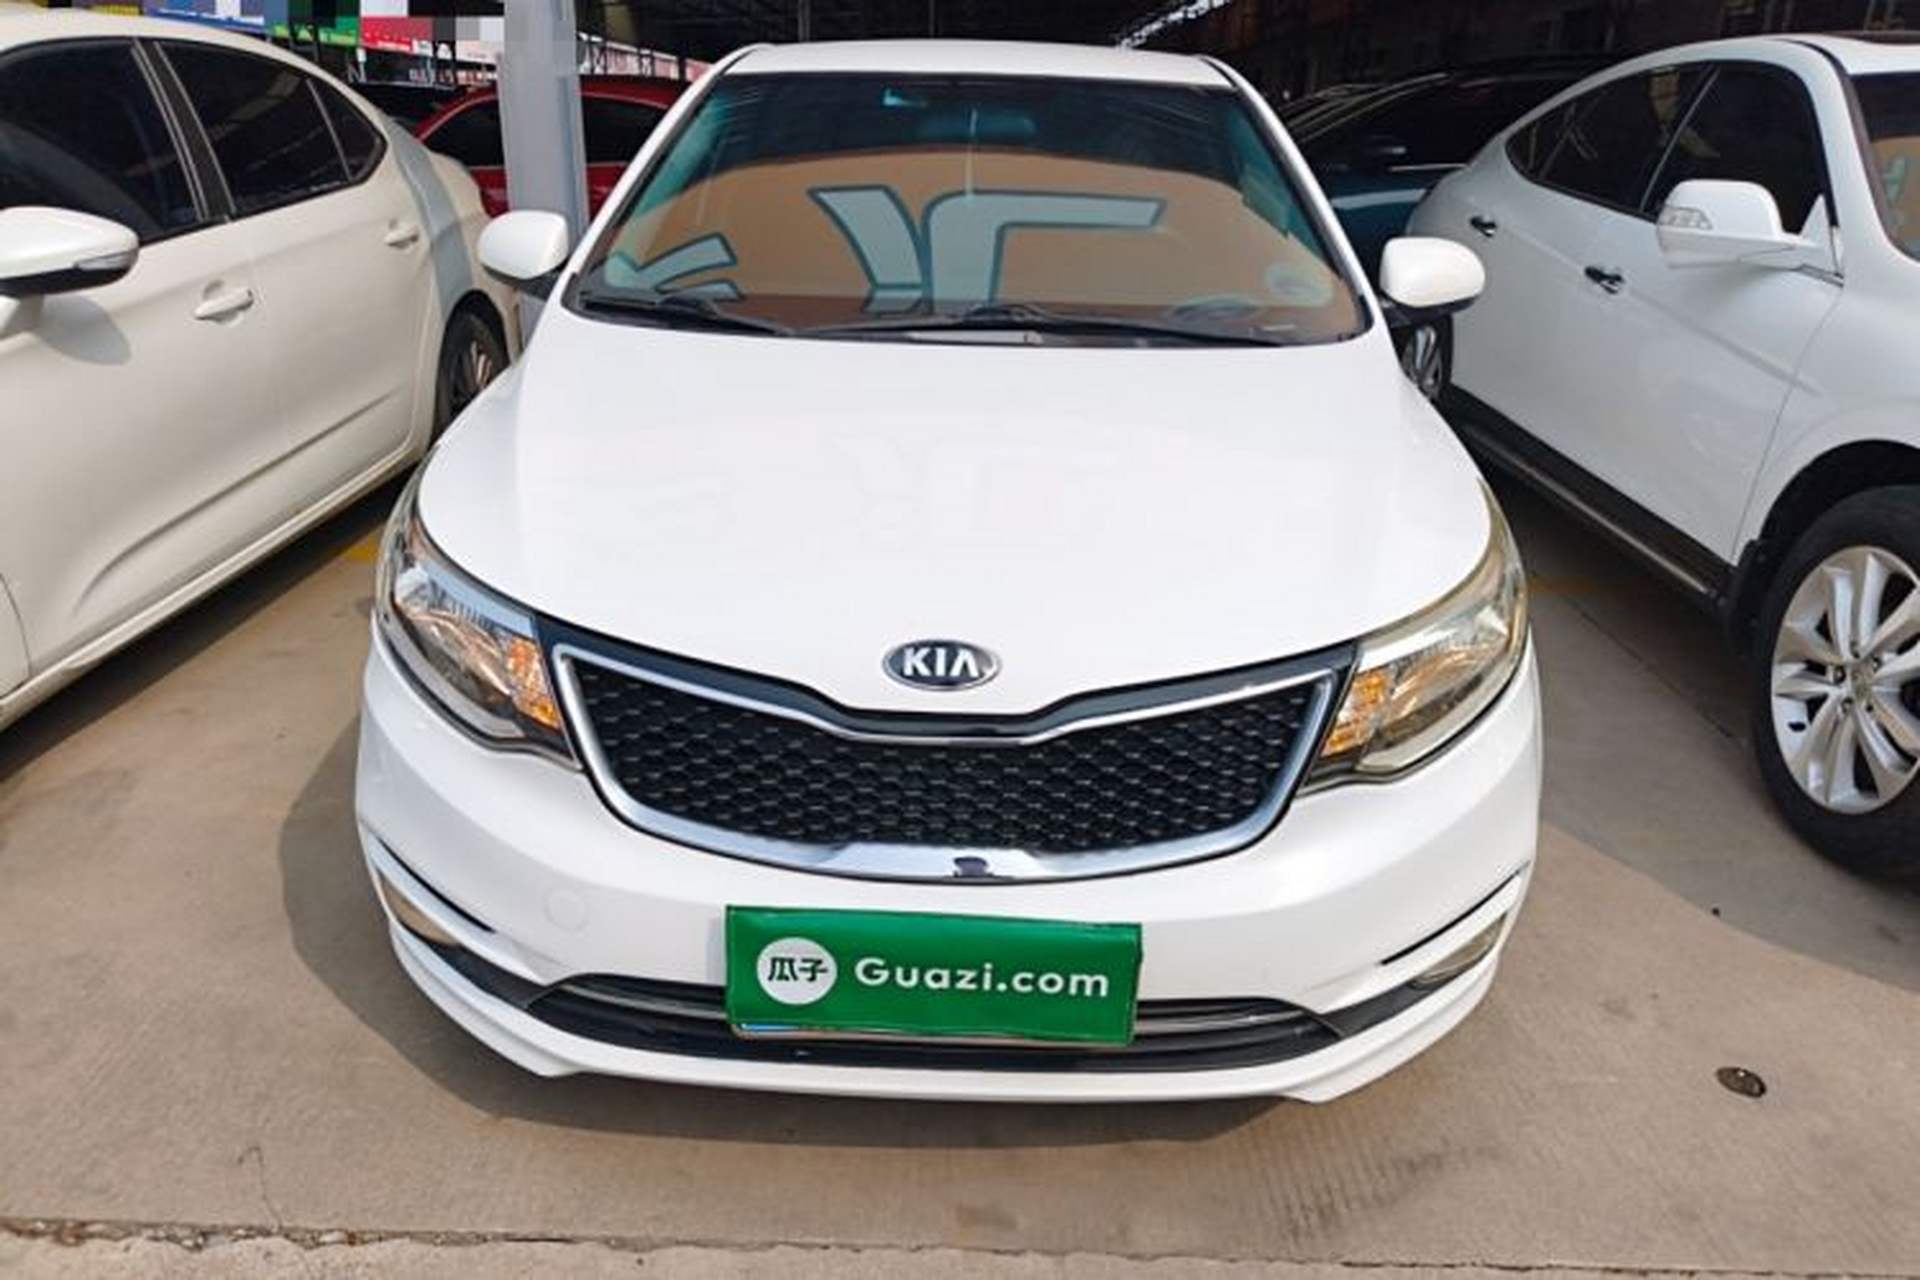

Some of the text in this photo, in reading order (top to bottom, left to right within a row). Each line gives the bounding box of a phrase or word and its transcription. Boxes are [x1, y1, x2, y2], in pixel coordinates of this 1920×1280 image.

[903, 646, 979, 678] KIA
[767, 956, 828, 983] 瓜子
[854, 956, 1109, 997] Guazi.com
